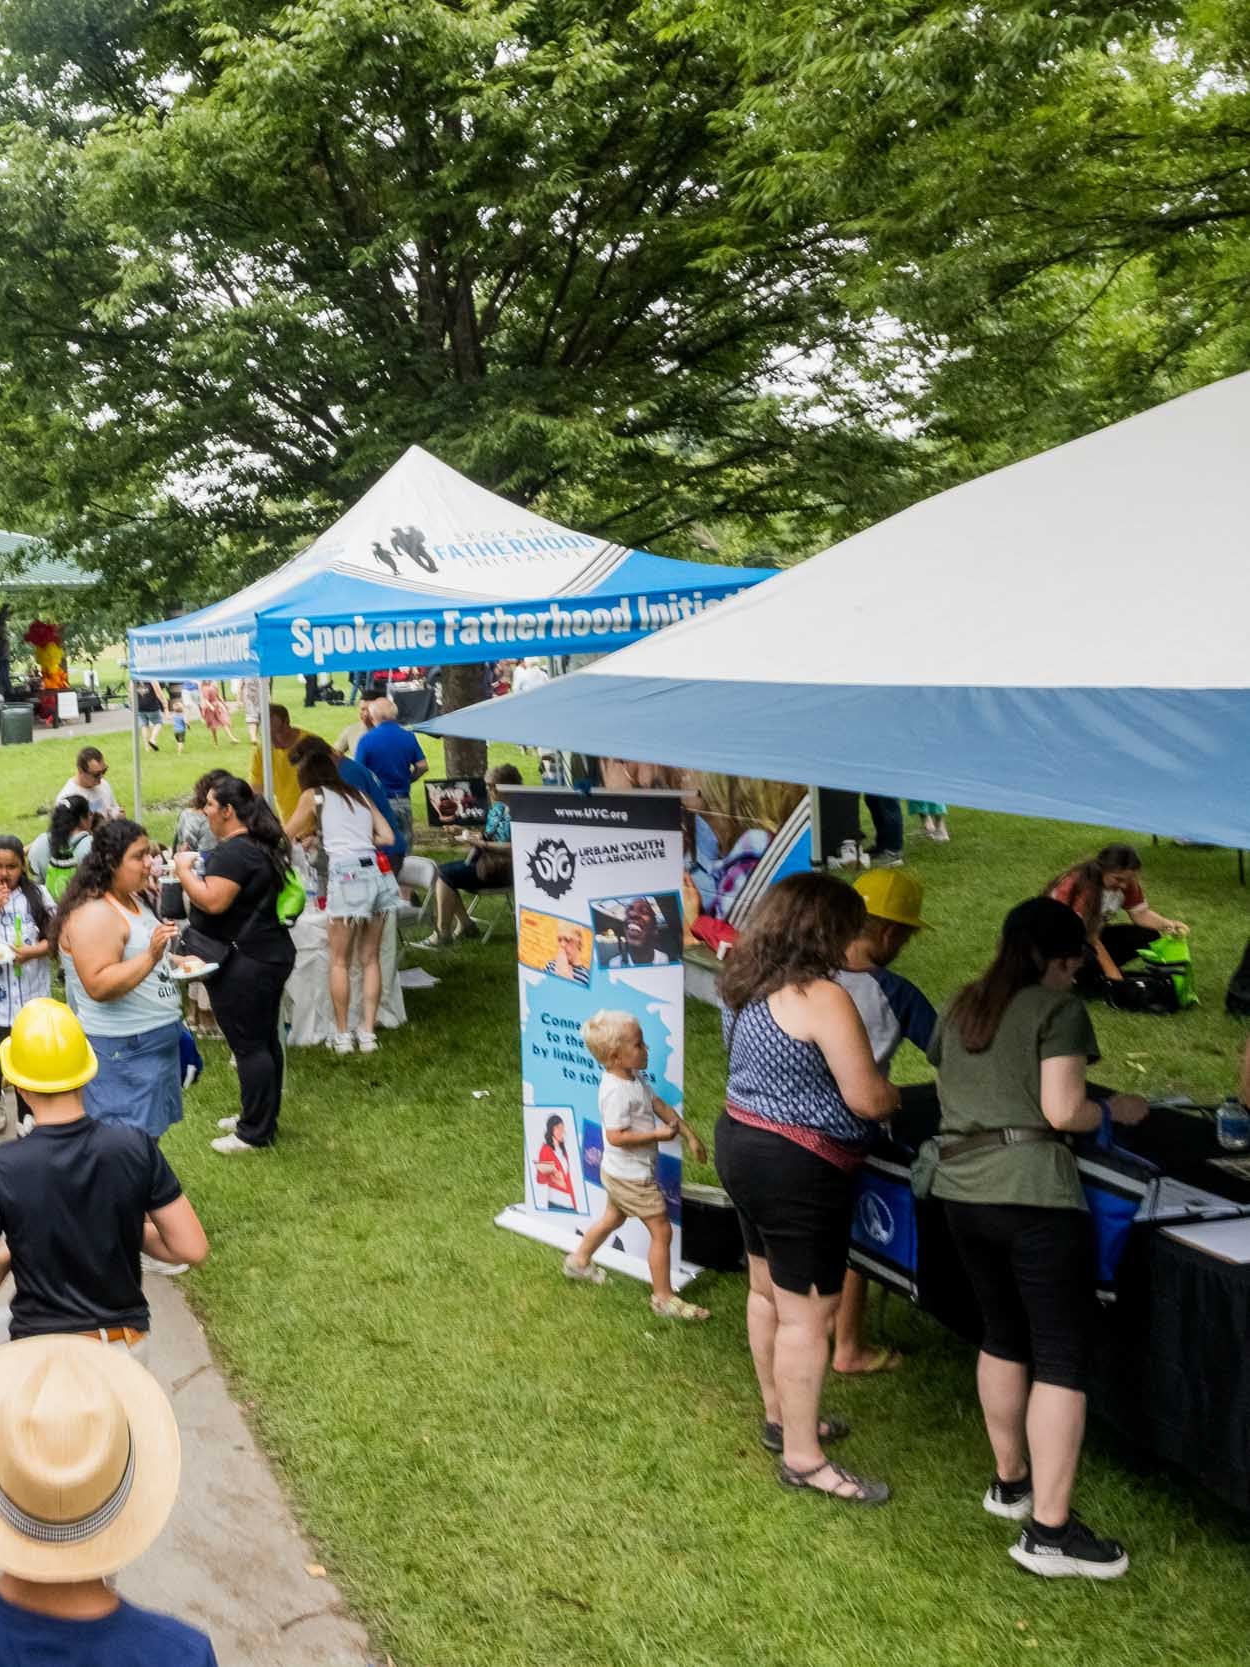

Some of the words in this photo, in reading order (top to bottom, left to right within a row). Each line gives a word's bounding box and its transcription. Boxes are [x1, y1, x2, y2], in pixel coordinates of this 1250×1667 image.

[434, 534, 596, 562] FATHERHOOD
[291, 616, 437, 666] Spokane
[443, 597, 632, 646] Fatherhood
[554, 807, 629, 823] www.UYC.org
[578, 842, 620, 857] URBAN
[622, 838, 665, 852] YOUTH
[534, 847, 573, 883] UYC
[580, 849, 666, 867] COLLABORATIVE
[541, 1012, 582, 1031] Conne
[545, 1030, 561, 1043] to
[565, 1034, 585, 1049] the
[532, 1042, 548, 1058] by
[553, 1048, 594, 1070] linking
[562, 1066, 576, 1080] to
[579, 1072, 600, 1087] sch
